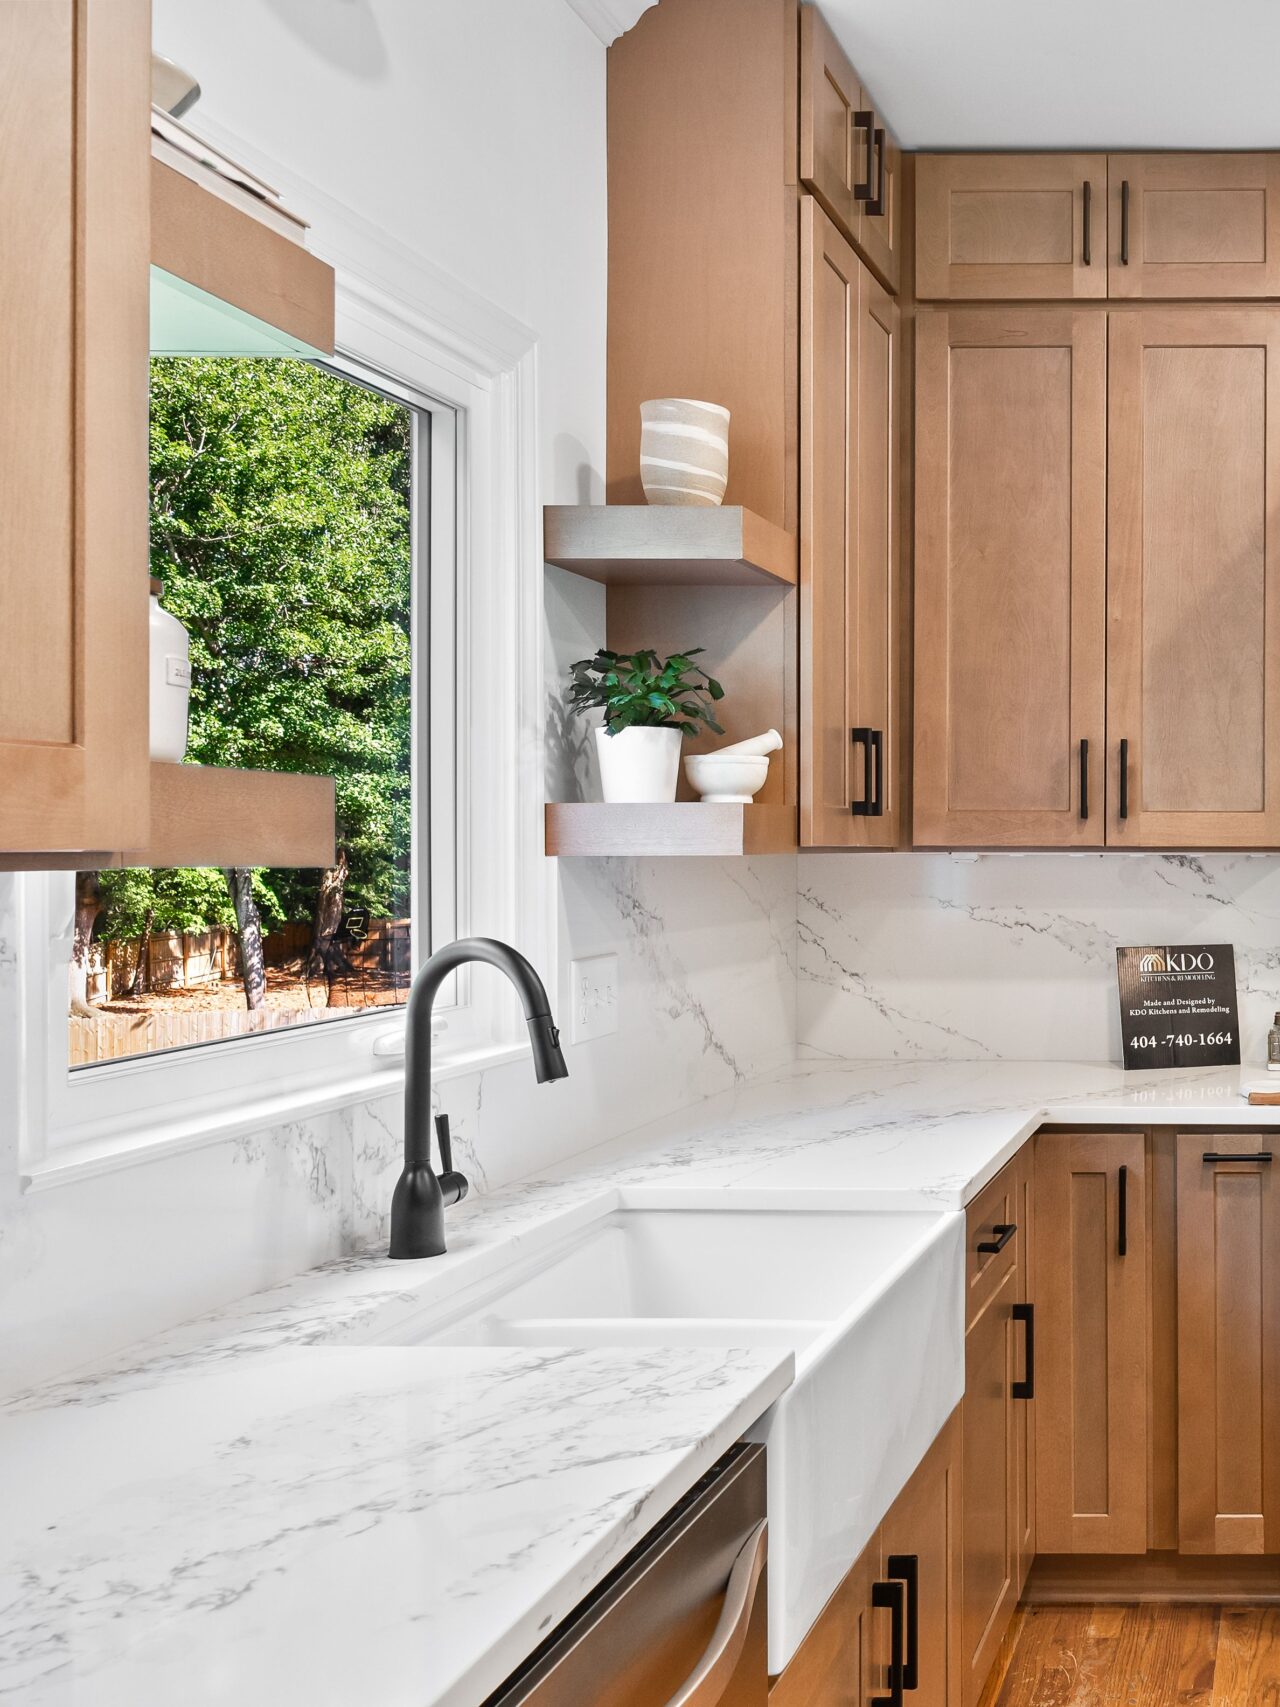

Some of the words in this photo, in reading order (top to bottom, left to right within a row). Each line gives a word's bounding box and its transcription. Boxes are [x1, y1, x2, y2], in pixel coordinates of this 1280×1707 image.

[1166, 953, 1214, 971] KDO
[1176, 998, 1206, 1006] Designed
[1207, 997, 1216, 1005] by
[1191, 1006, 1230, 1014] Remodeling
[1130, 1035, 1157, 1049] 404
